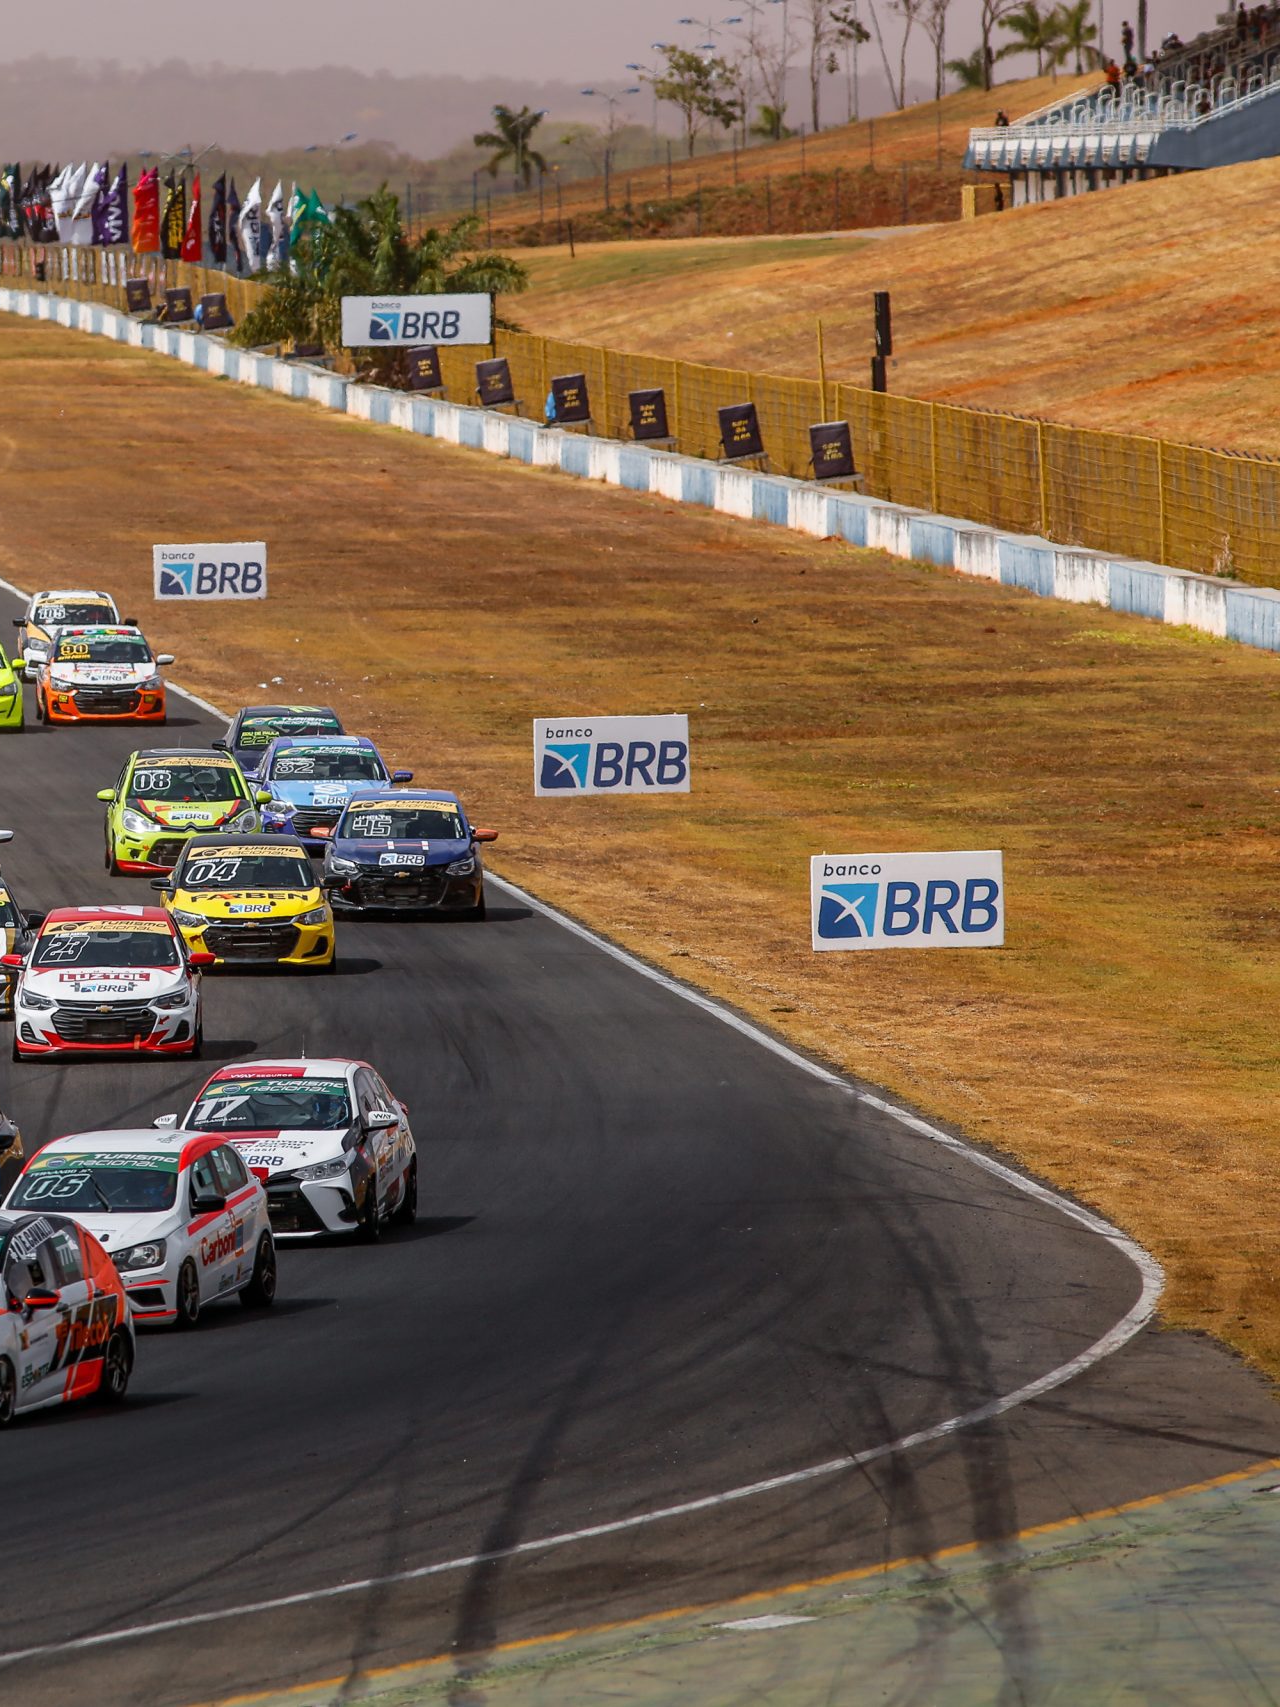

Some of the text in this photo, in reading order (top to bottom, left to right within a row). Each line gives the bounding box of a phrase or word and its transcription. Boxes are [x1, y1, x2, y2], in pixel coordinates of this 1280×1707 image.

[371, 301, 402, 309] banco
[401, 310, 460, 339] BRB
[161, 551, 195, 560] banco
[196, 562, 262, 595] BRB
[545, 727, 593, 739] banco
[275, 761, 315, 774] 82
[592, 740, 688, 788] BRB
[133, 771, 172, 792] 08
[352, 819, 393, 837] 45
[396, 855, 425, 865] BRB
[185, 861, 241, 885] 04
[822, 863, 882, 876] banco
[191, 892, 309, 903] FARBEN
[243, 904, 272, 913] BRB
[882, 878, 999, 937] BRB
[99, 920, 168, 928] TURISMO
[63, 973, 149, 982] LUZTOL
[97, 985, 128, 993] BRB
[267, 1080, 348, 1089] TURISMO
[194, 1095, 251, 1121] 17
[93, 1153, 179, 1164] TURISMO
[248, 1155, 285, 1166] BRB
[23, 1174, 91, 1201] 06
